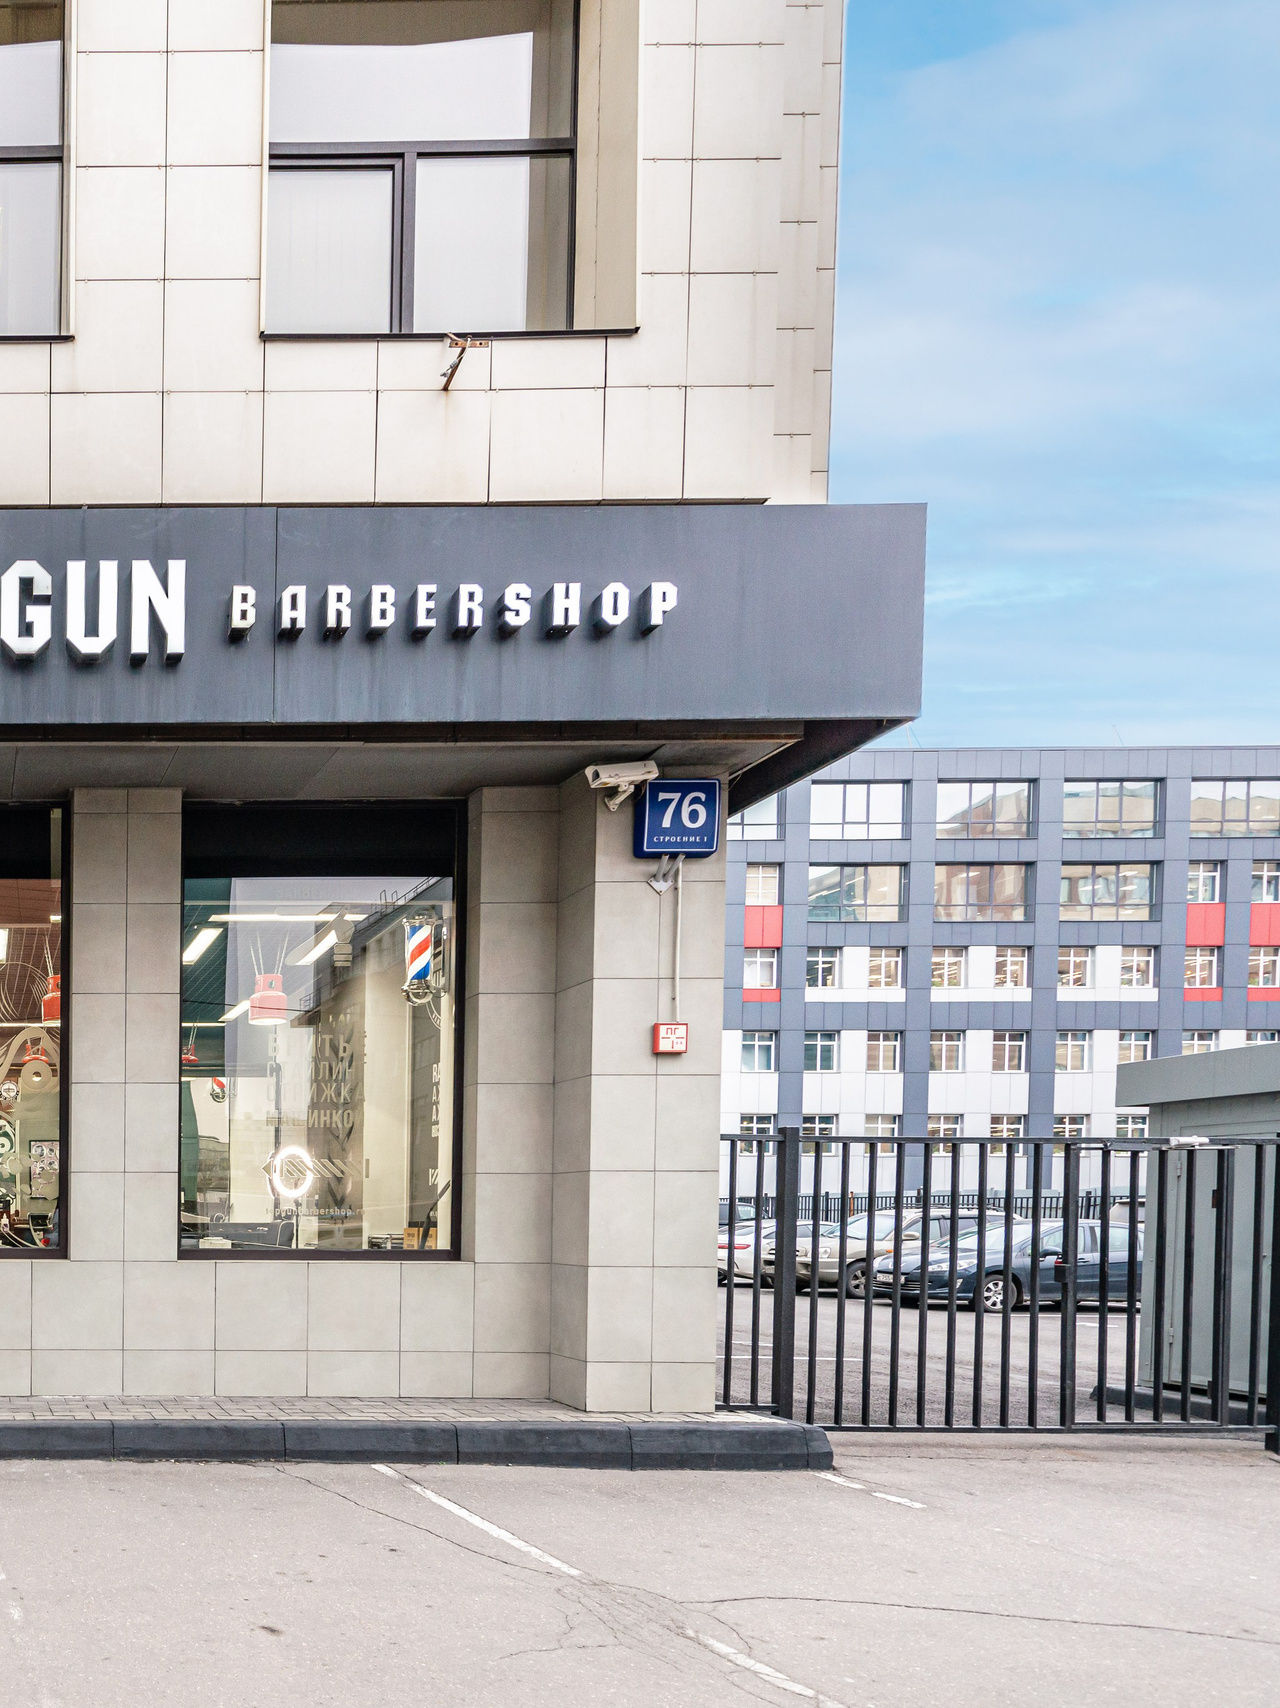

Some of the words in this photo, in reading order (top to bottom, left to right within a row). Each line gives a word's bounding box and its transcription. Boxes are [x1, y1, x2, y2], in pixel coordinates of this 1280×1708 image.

[228, 581, 678, 635] BARBERSHOP
[658, 791, 707, 829] 76
[653, 835, 701, 843] СТРОЕНИЕ
